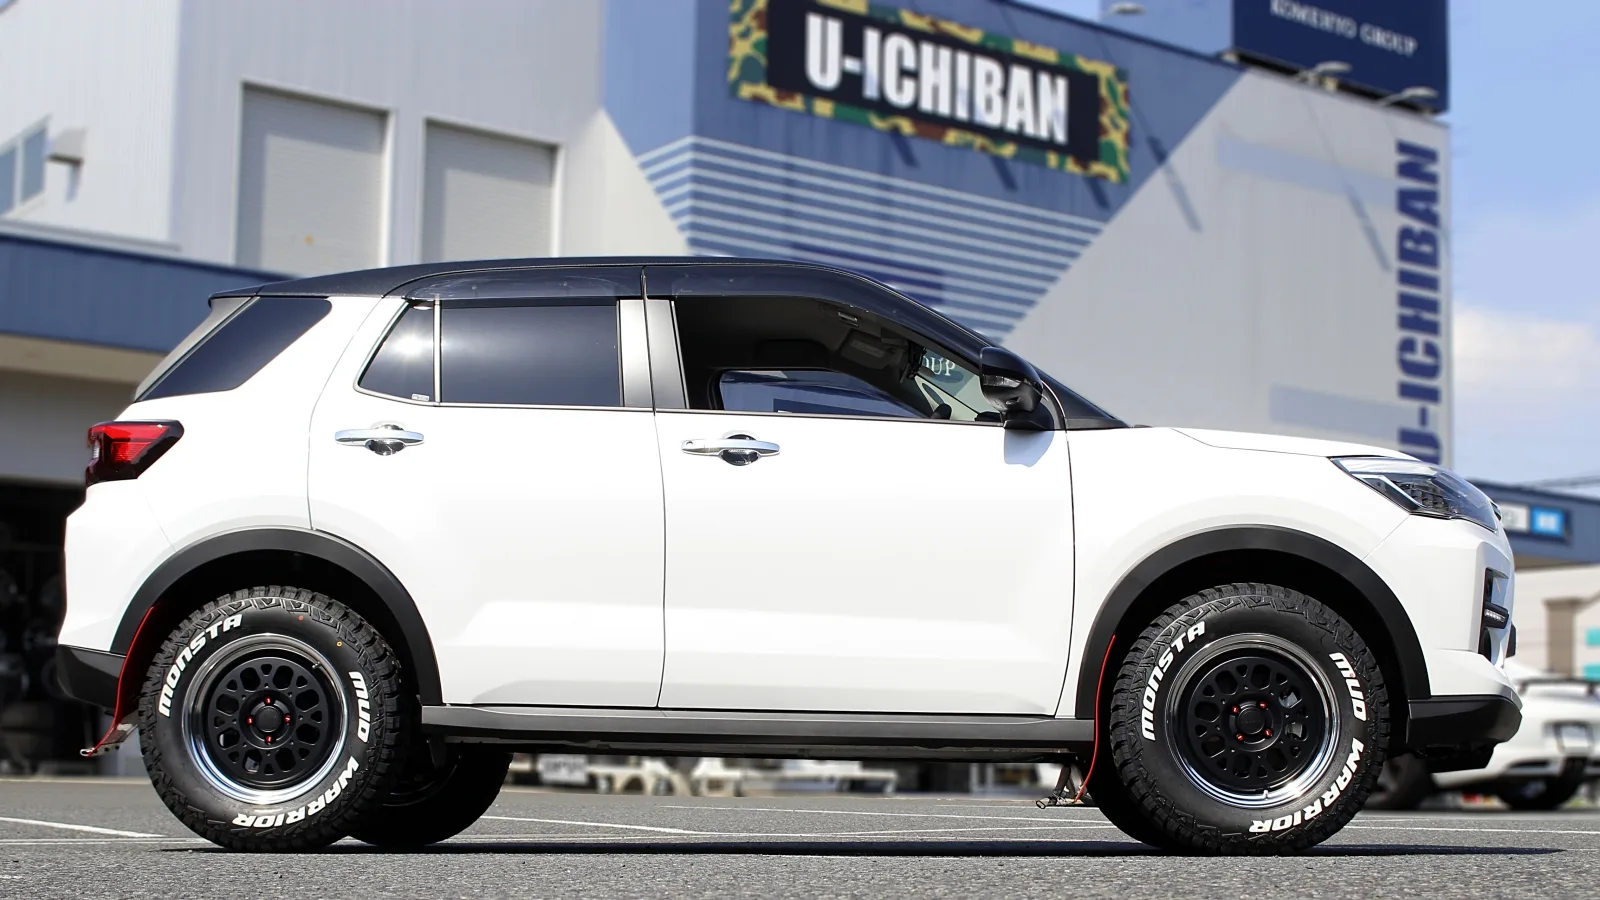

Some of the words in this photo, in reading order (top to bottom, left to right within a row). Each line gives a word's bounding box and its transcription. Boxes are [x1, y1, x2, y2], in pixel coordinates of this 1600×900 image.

[805, 12, 1069, 145] U-ICHIBAN
[1359, 22, 1418, 57] GROUP
[158, 613, 243, 718] MONSTA
[348, 671, 372, 743] MUD
[1141, 621, 1206, 741] MONSTA
[1328, 652, 1367, 722] MUD
[232, 756, 360, 828] WARRIOR
[1249, 737, 1364, 833] WARRIOR
